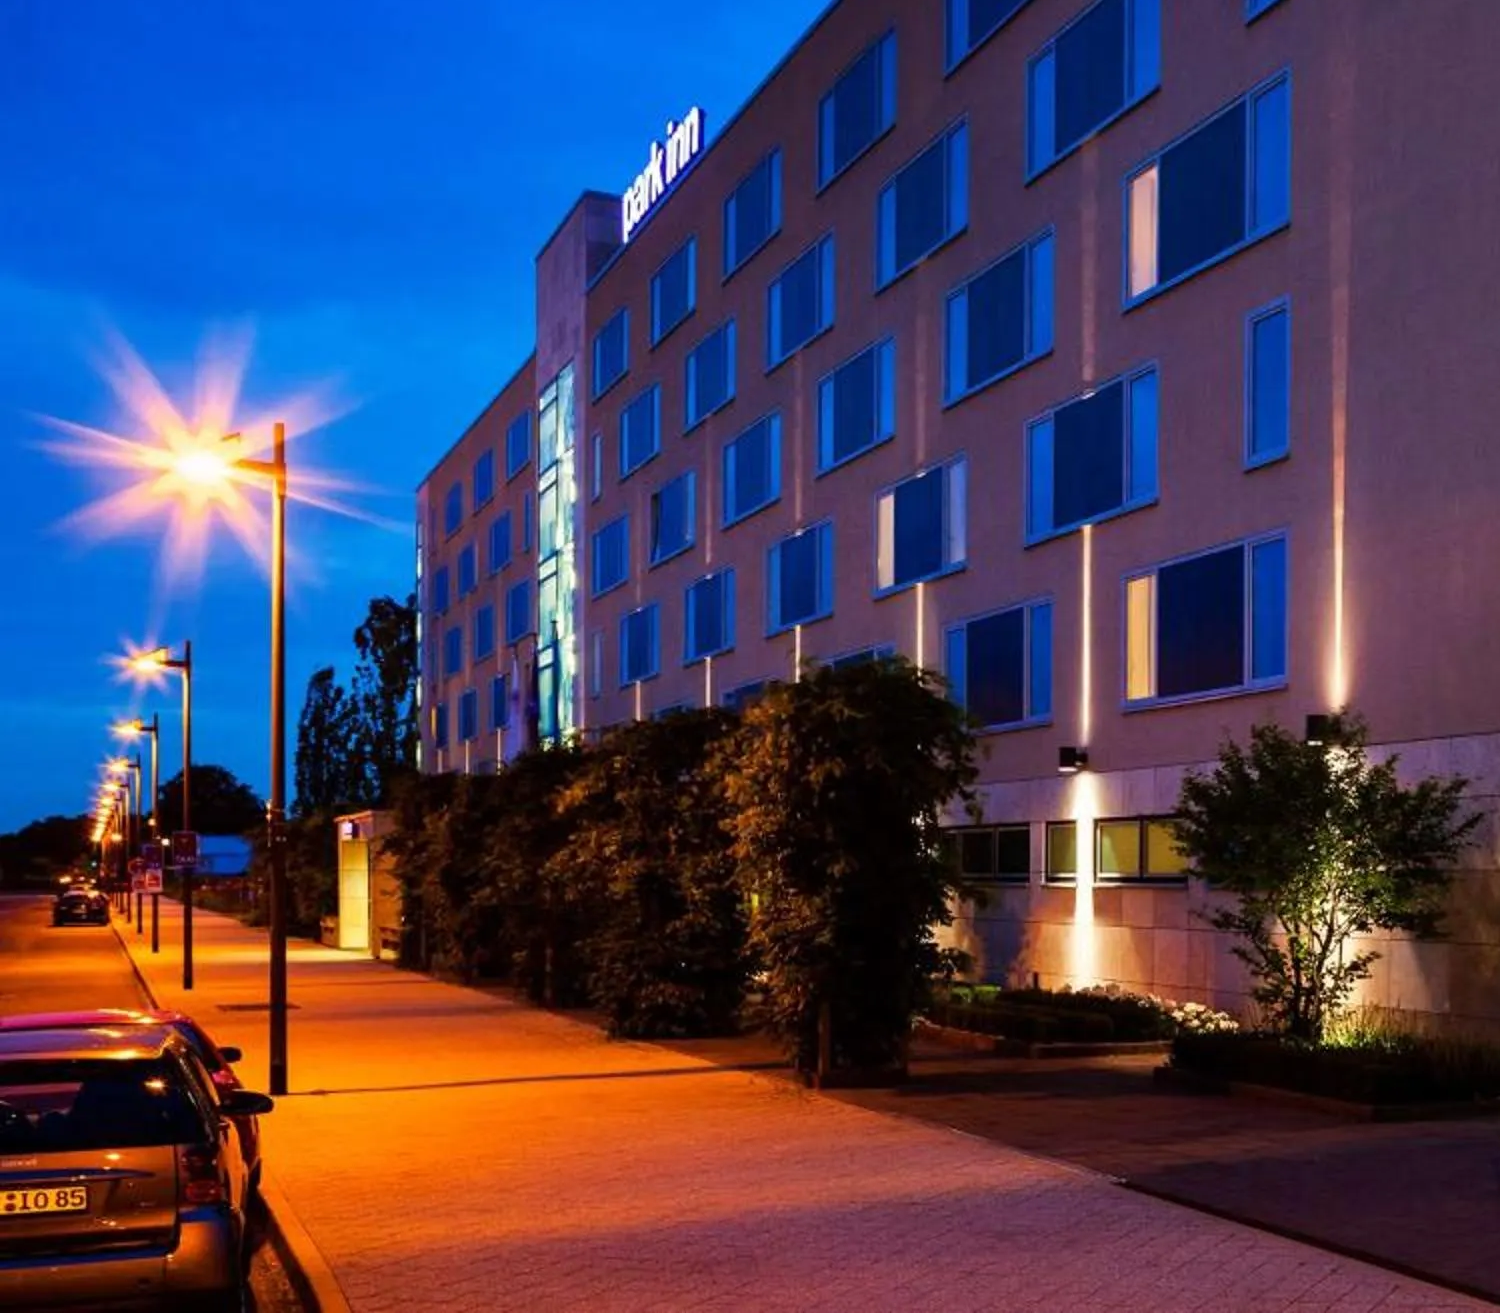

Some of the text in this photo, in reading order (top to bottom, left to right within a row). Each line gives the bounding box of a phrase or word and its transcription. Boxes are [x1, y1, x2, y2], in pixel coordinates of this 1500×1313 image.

[622, 106, 700, 244] park inn
[55, 1189, 85, 1208] 85
